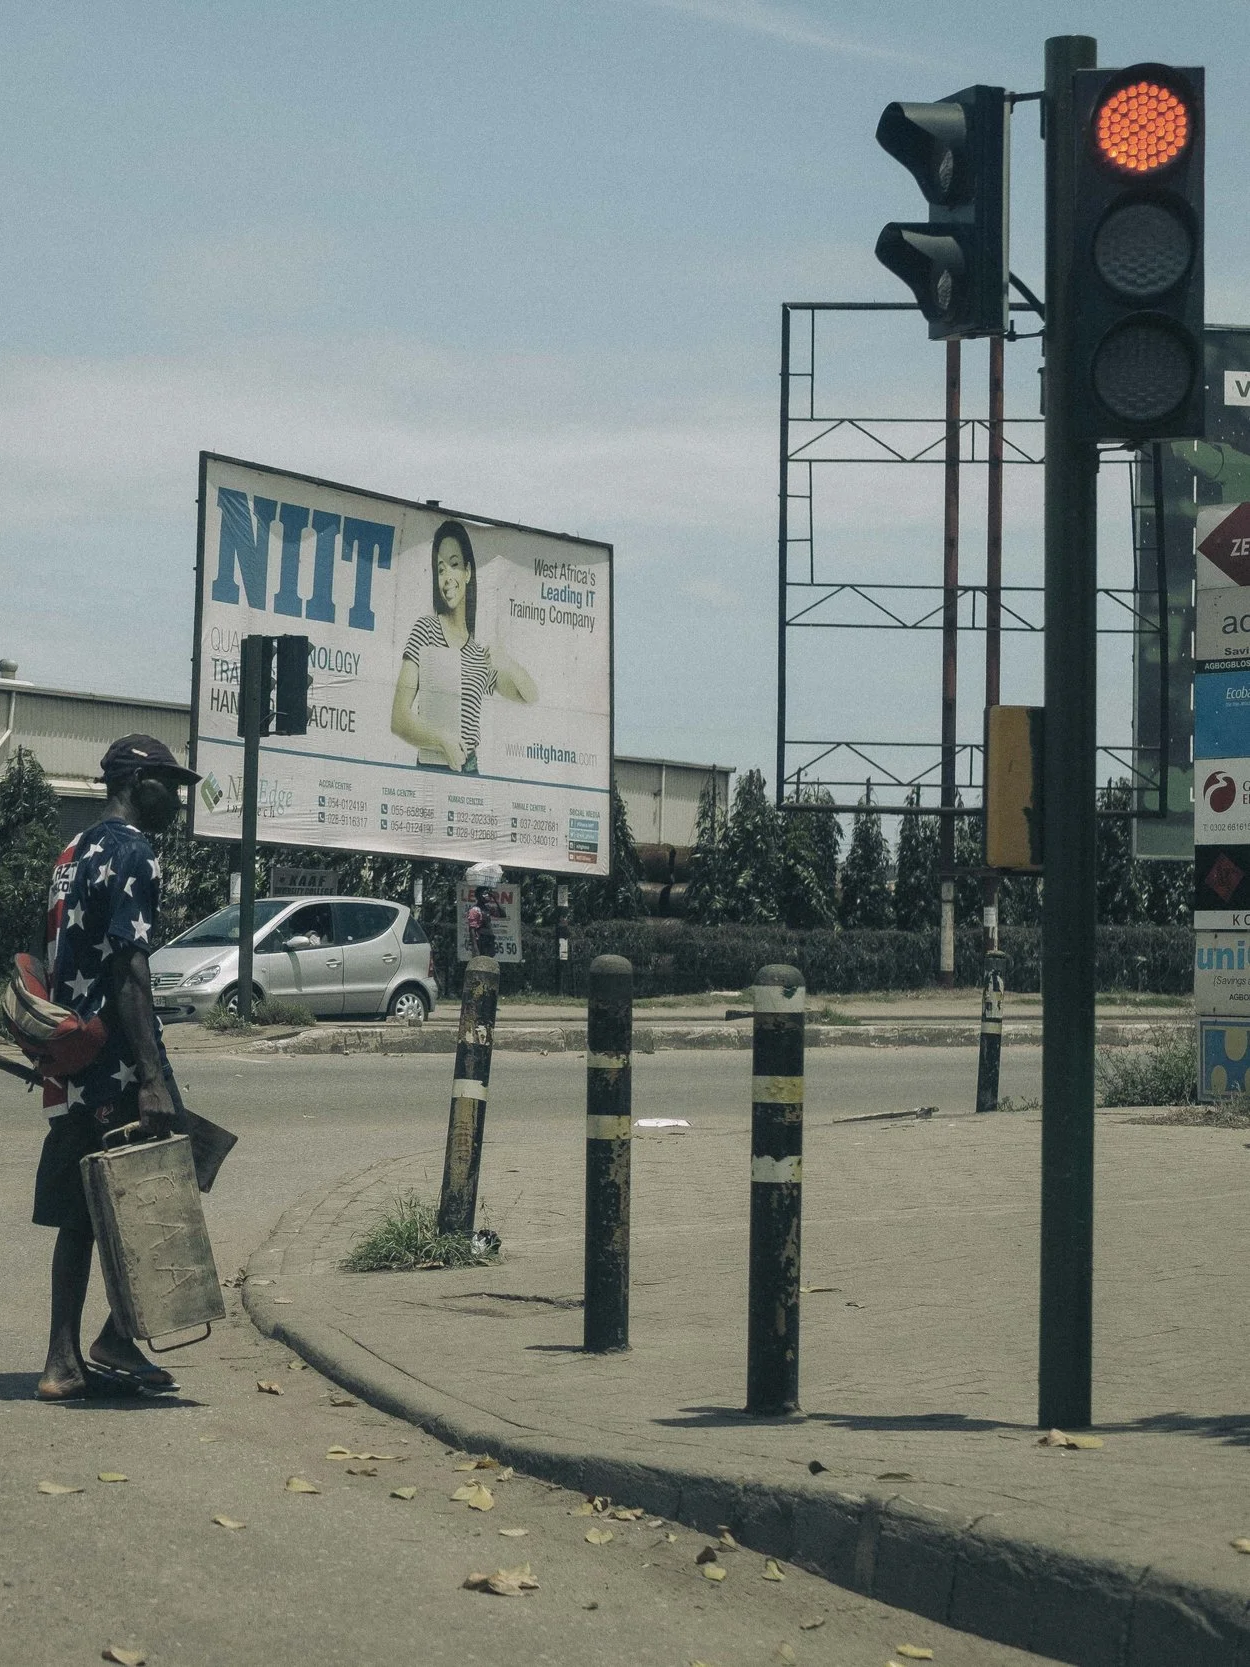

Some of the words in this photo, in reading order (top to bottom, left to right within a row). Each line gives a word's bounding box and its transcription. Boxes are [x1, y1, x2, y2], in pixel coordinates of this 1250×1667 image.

[212, 486, 396, 632] NIIT
[534, 558, 558, 579] West
[560, 564, 596, 586] Africa's
[541, 582, 582, 609] Leading
[586, 590, 596, 608] IT
[510, 598, 546, 626] Training
[550, 605, 595, 633] Company
[310, 645, 360, 676] NOLOGY
[210, 688, 239, 715] HAN
[308, 704, 356, 733] ACTICE
[289, 875, 326, 886] KAAF
[1213, 975, 1247, 988] (Savings
